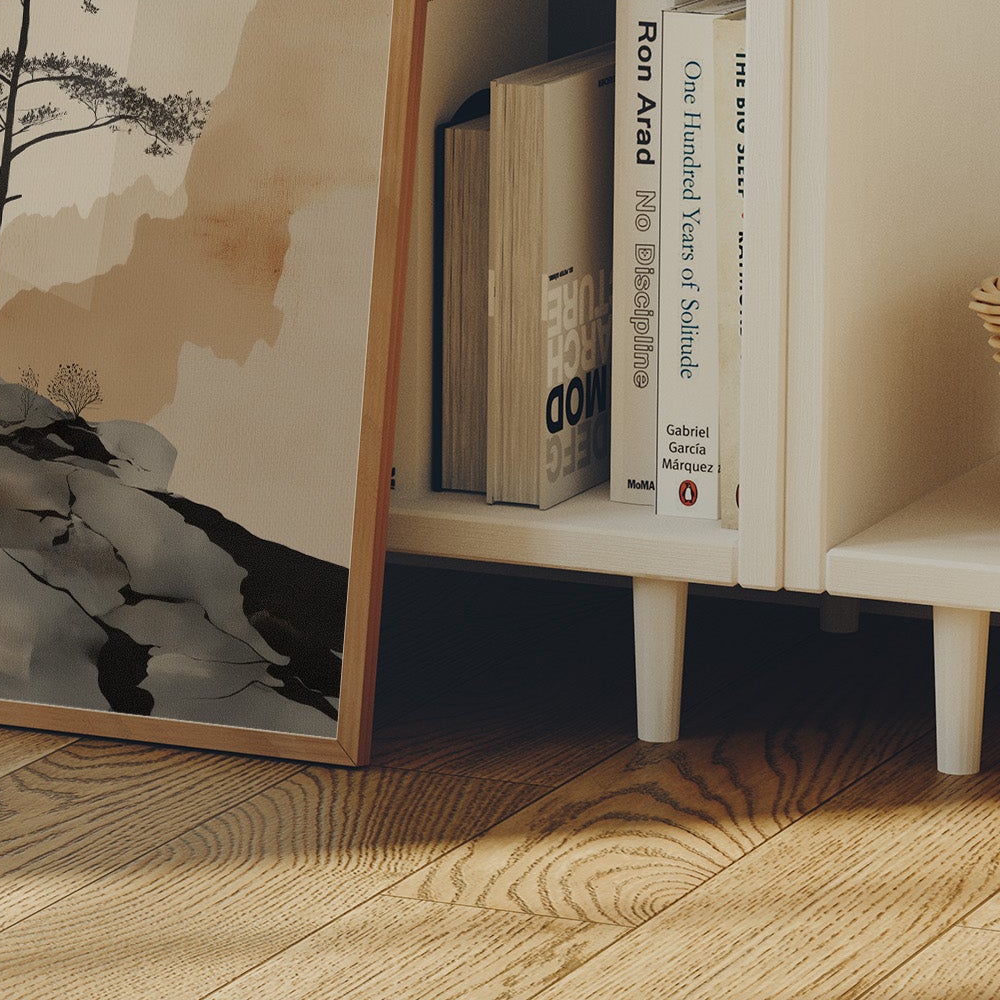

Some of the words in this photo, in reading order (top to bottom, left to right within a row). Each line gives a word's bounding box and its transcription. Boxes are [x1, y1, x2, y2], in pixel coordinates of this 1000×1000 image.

[637, 21, 657, 81] Ron
[684, 61, 702, 104] One
[636, 92, 657, 165] Arad
[682, 112, 702, 201] Hundred
[635, 190, 657, 232] No
[681, 207, 701, 261] Years
[681, 268, 700, 292] of
[629, 244, 655, 389] Discipline
[680, 298, 700, 379] Solitude
[546, 365, 607, 434] MOD
[666, 424, 710, 439] Gabriel
[668, 441, 706, 456] García
[627, 479, 655, 491] MoMA
[662, 458, 714, 474] Márquez
